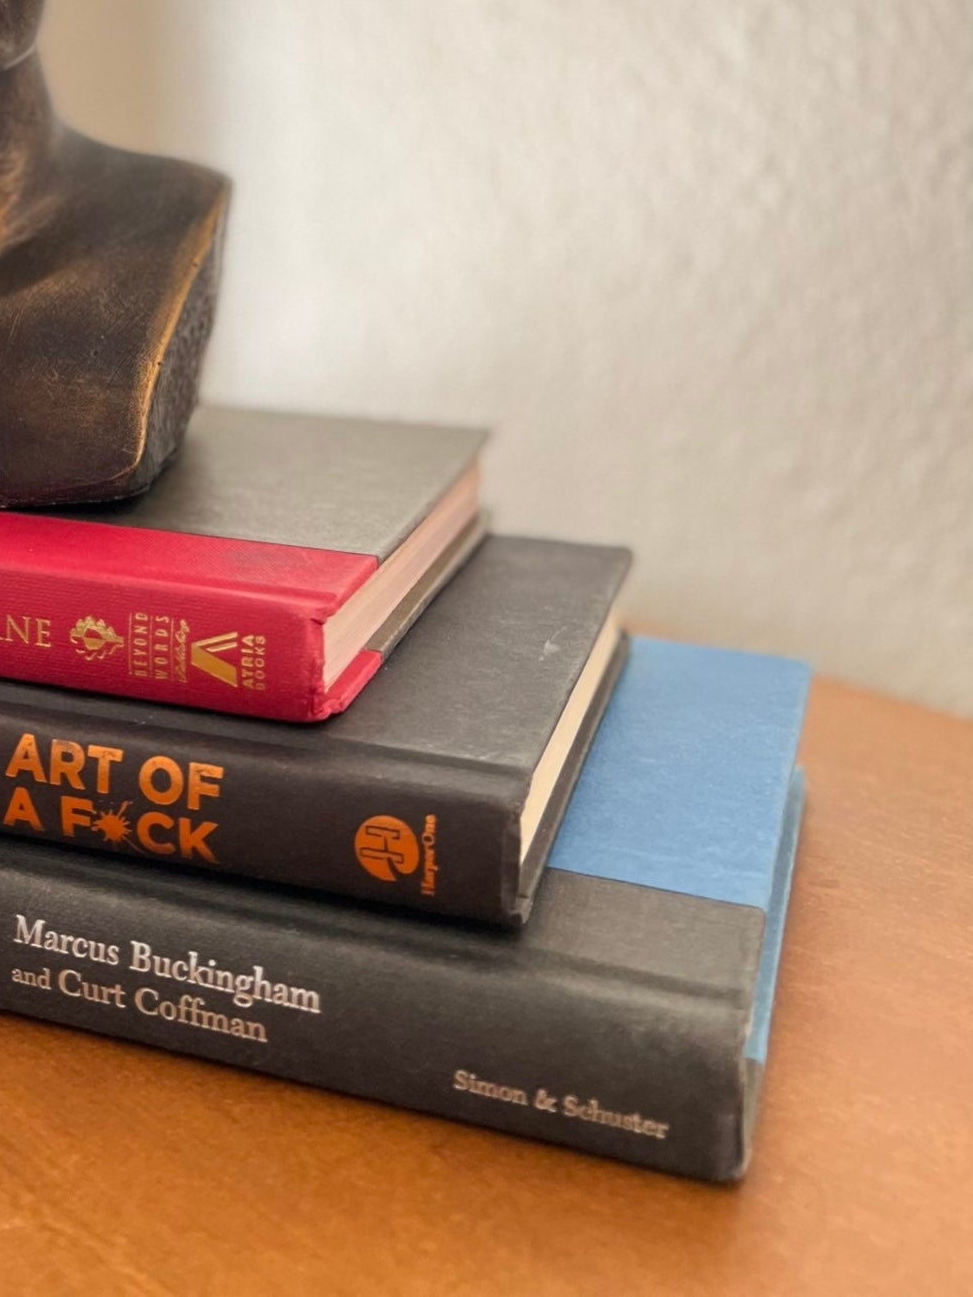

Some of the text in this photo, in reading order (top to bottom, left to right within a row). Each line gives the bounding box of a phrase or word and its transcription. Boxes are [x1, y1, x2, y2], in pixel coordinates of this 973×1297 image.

[133, 612, 148, 677] BEYOND
[155, 615, 170, 680] WORDS
[241, 634, 255, 689] ATRIA
[255, 634, 266, 691] BOOKS
[5, 733, 123, 794] ART
[138, 755, 224, 811] OF
[3, 786, 45, 833] A
[13, 915, 321, 1014] Marcus Buckingham
[12, 965, 268, 1043] and Curt Coffman
[453, 1069, 670, 1140] Simon & Schuster
